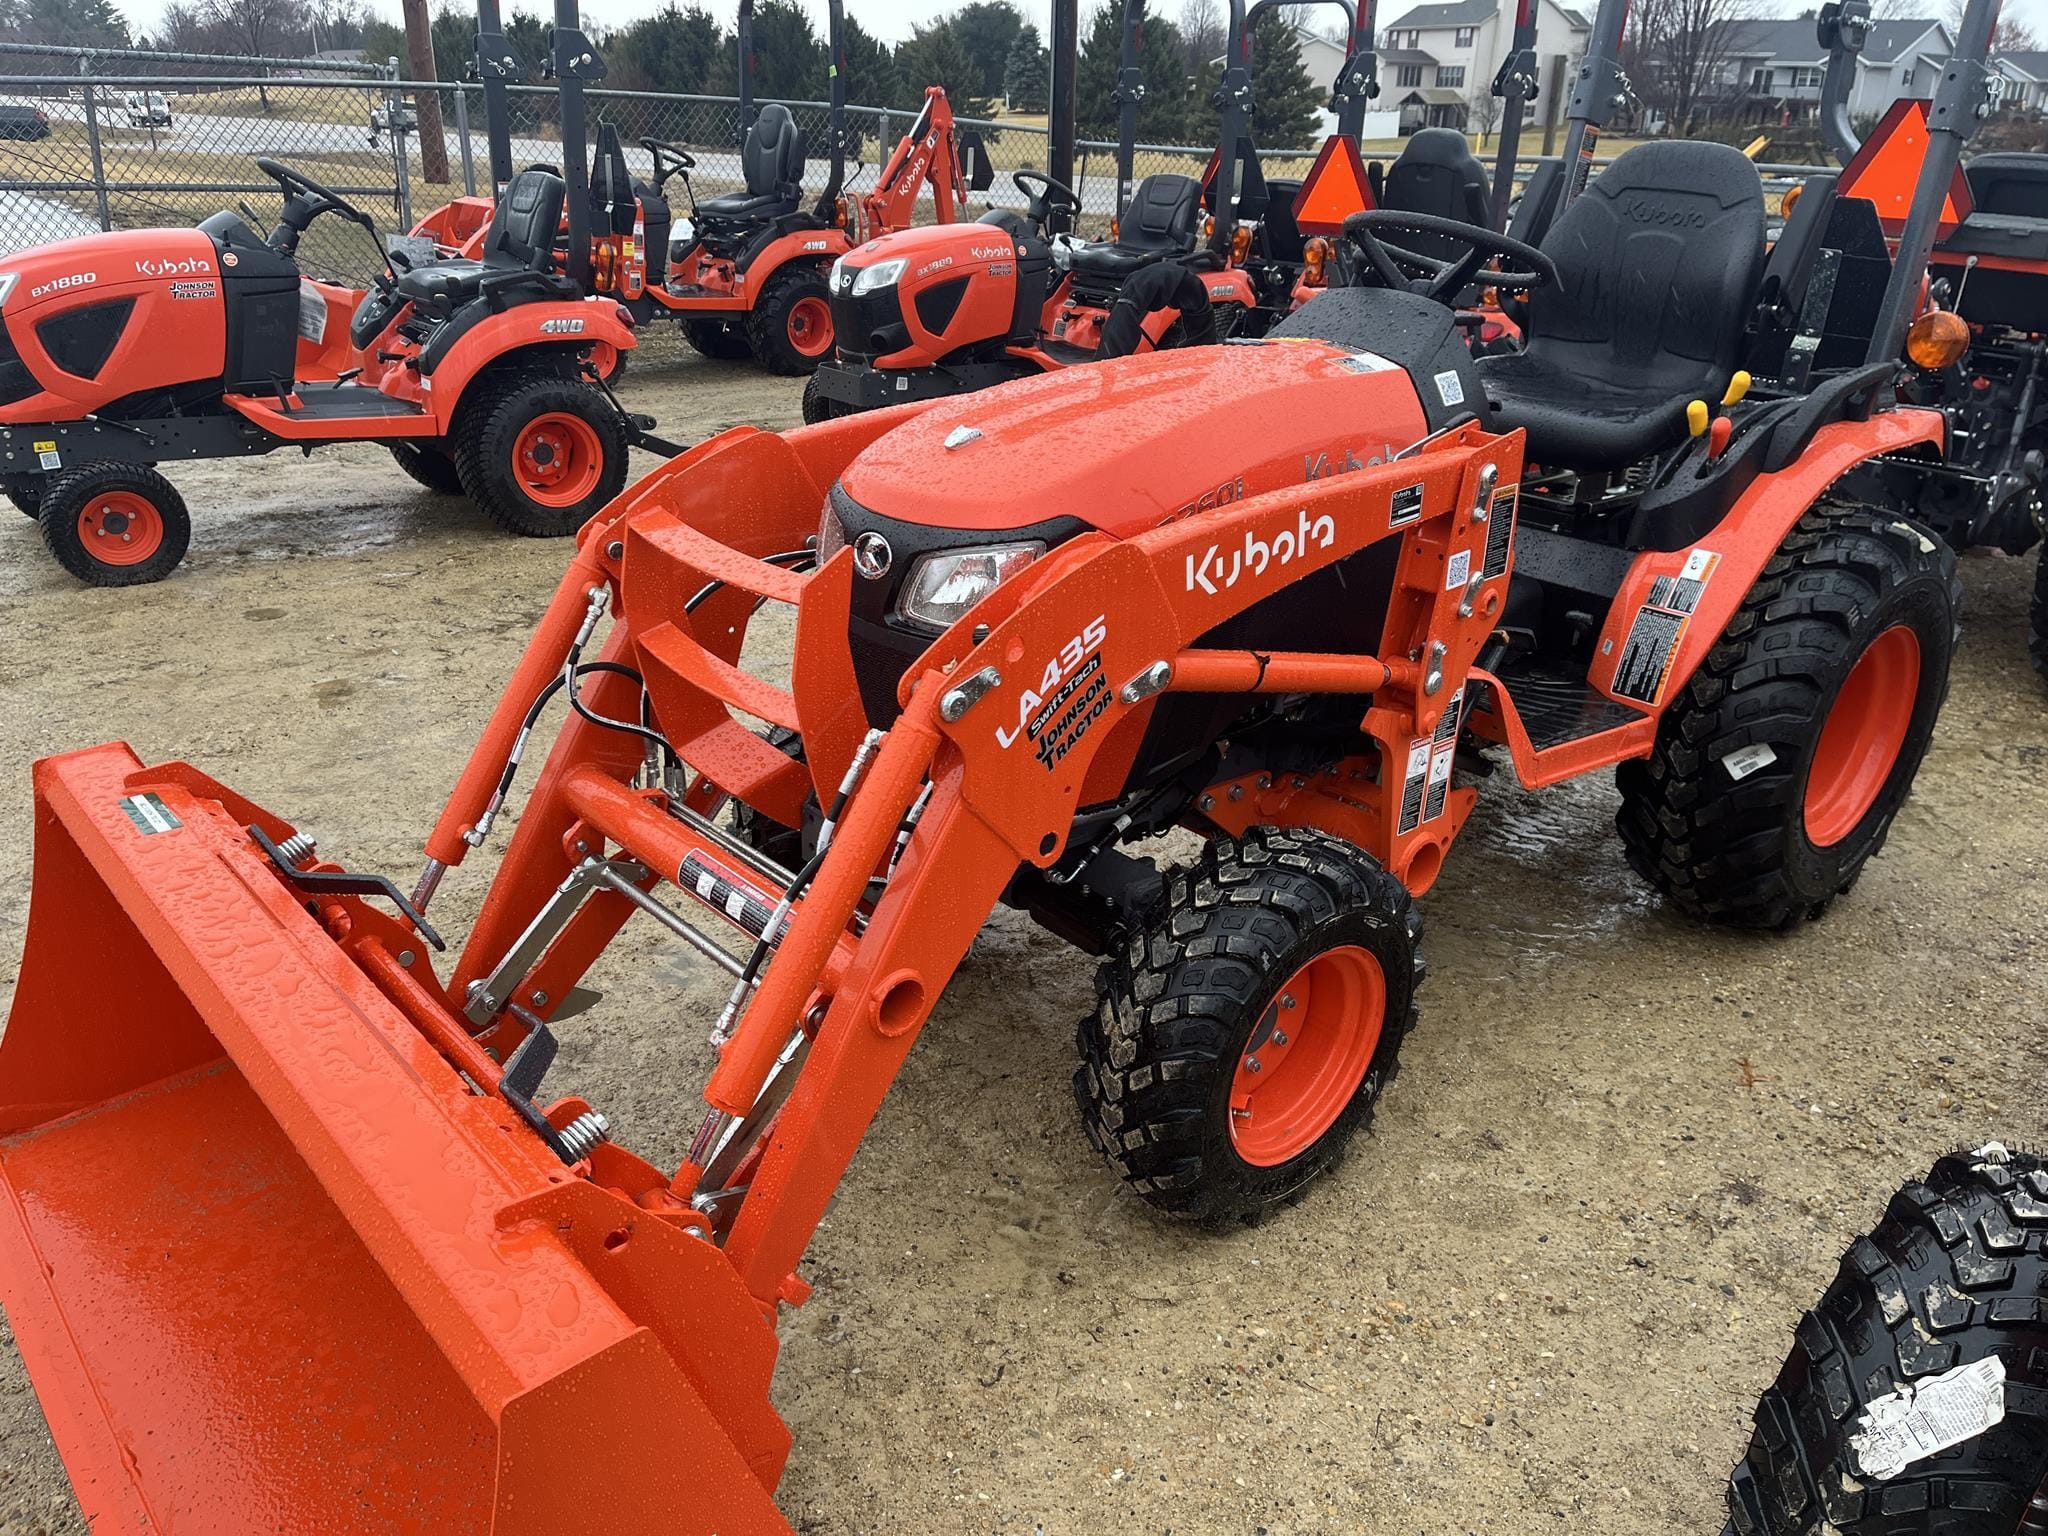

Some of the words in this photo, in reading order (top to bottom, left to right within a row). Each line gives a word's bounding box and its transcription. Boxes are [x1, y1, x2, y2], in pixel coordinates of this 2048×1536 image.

[899, 158, 924, 196] Kubota
[1623, 199, 1706, 229] Kubota
[803, 240, 827, 250] 4WD
[971, 246, 1012, 259] Kubota
[135, 257, 210, 276] Kubota
[31, 272, 97, 297] BX1880
[169, 281, 215, 290] JOHNSON
[172, 290, 215, 299] TRACTOR
[540, 319, 584, 333] 4WD
[1186, 510, 1335, 595] Kubota
[995, 614, 1106, 749] LA435
[1030, 657, 1099, 737] Swift-Tach
[1036, 672, 1107, 760] JOHNSON
[1041, 689, 1113, 773] TRACTOR
